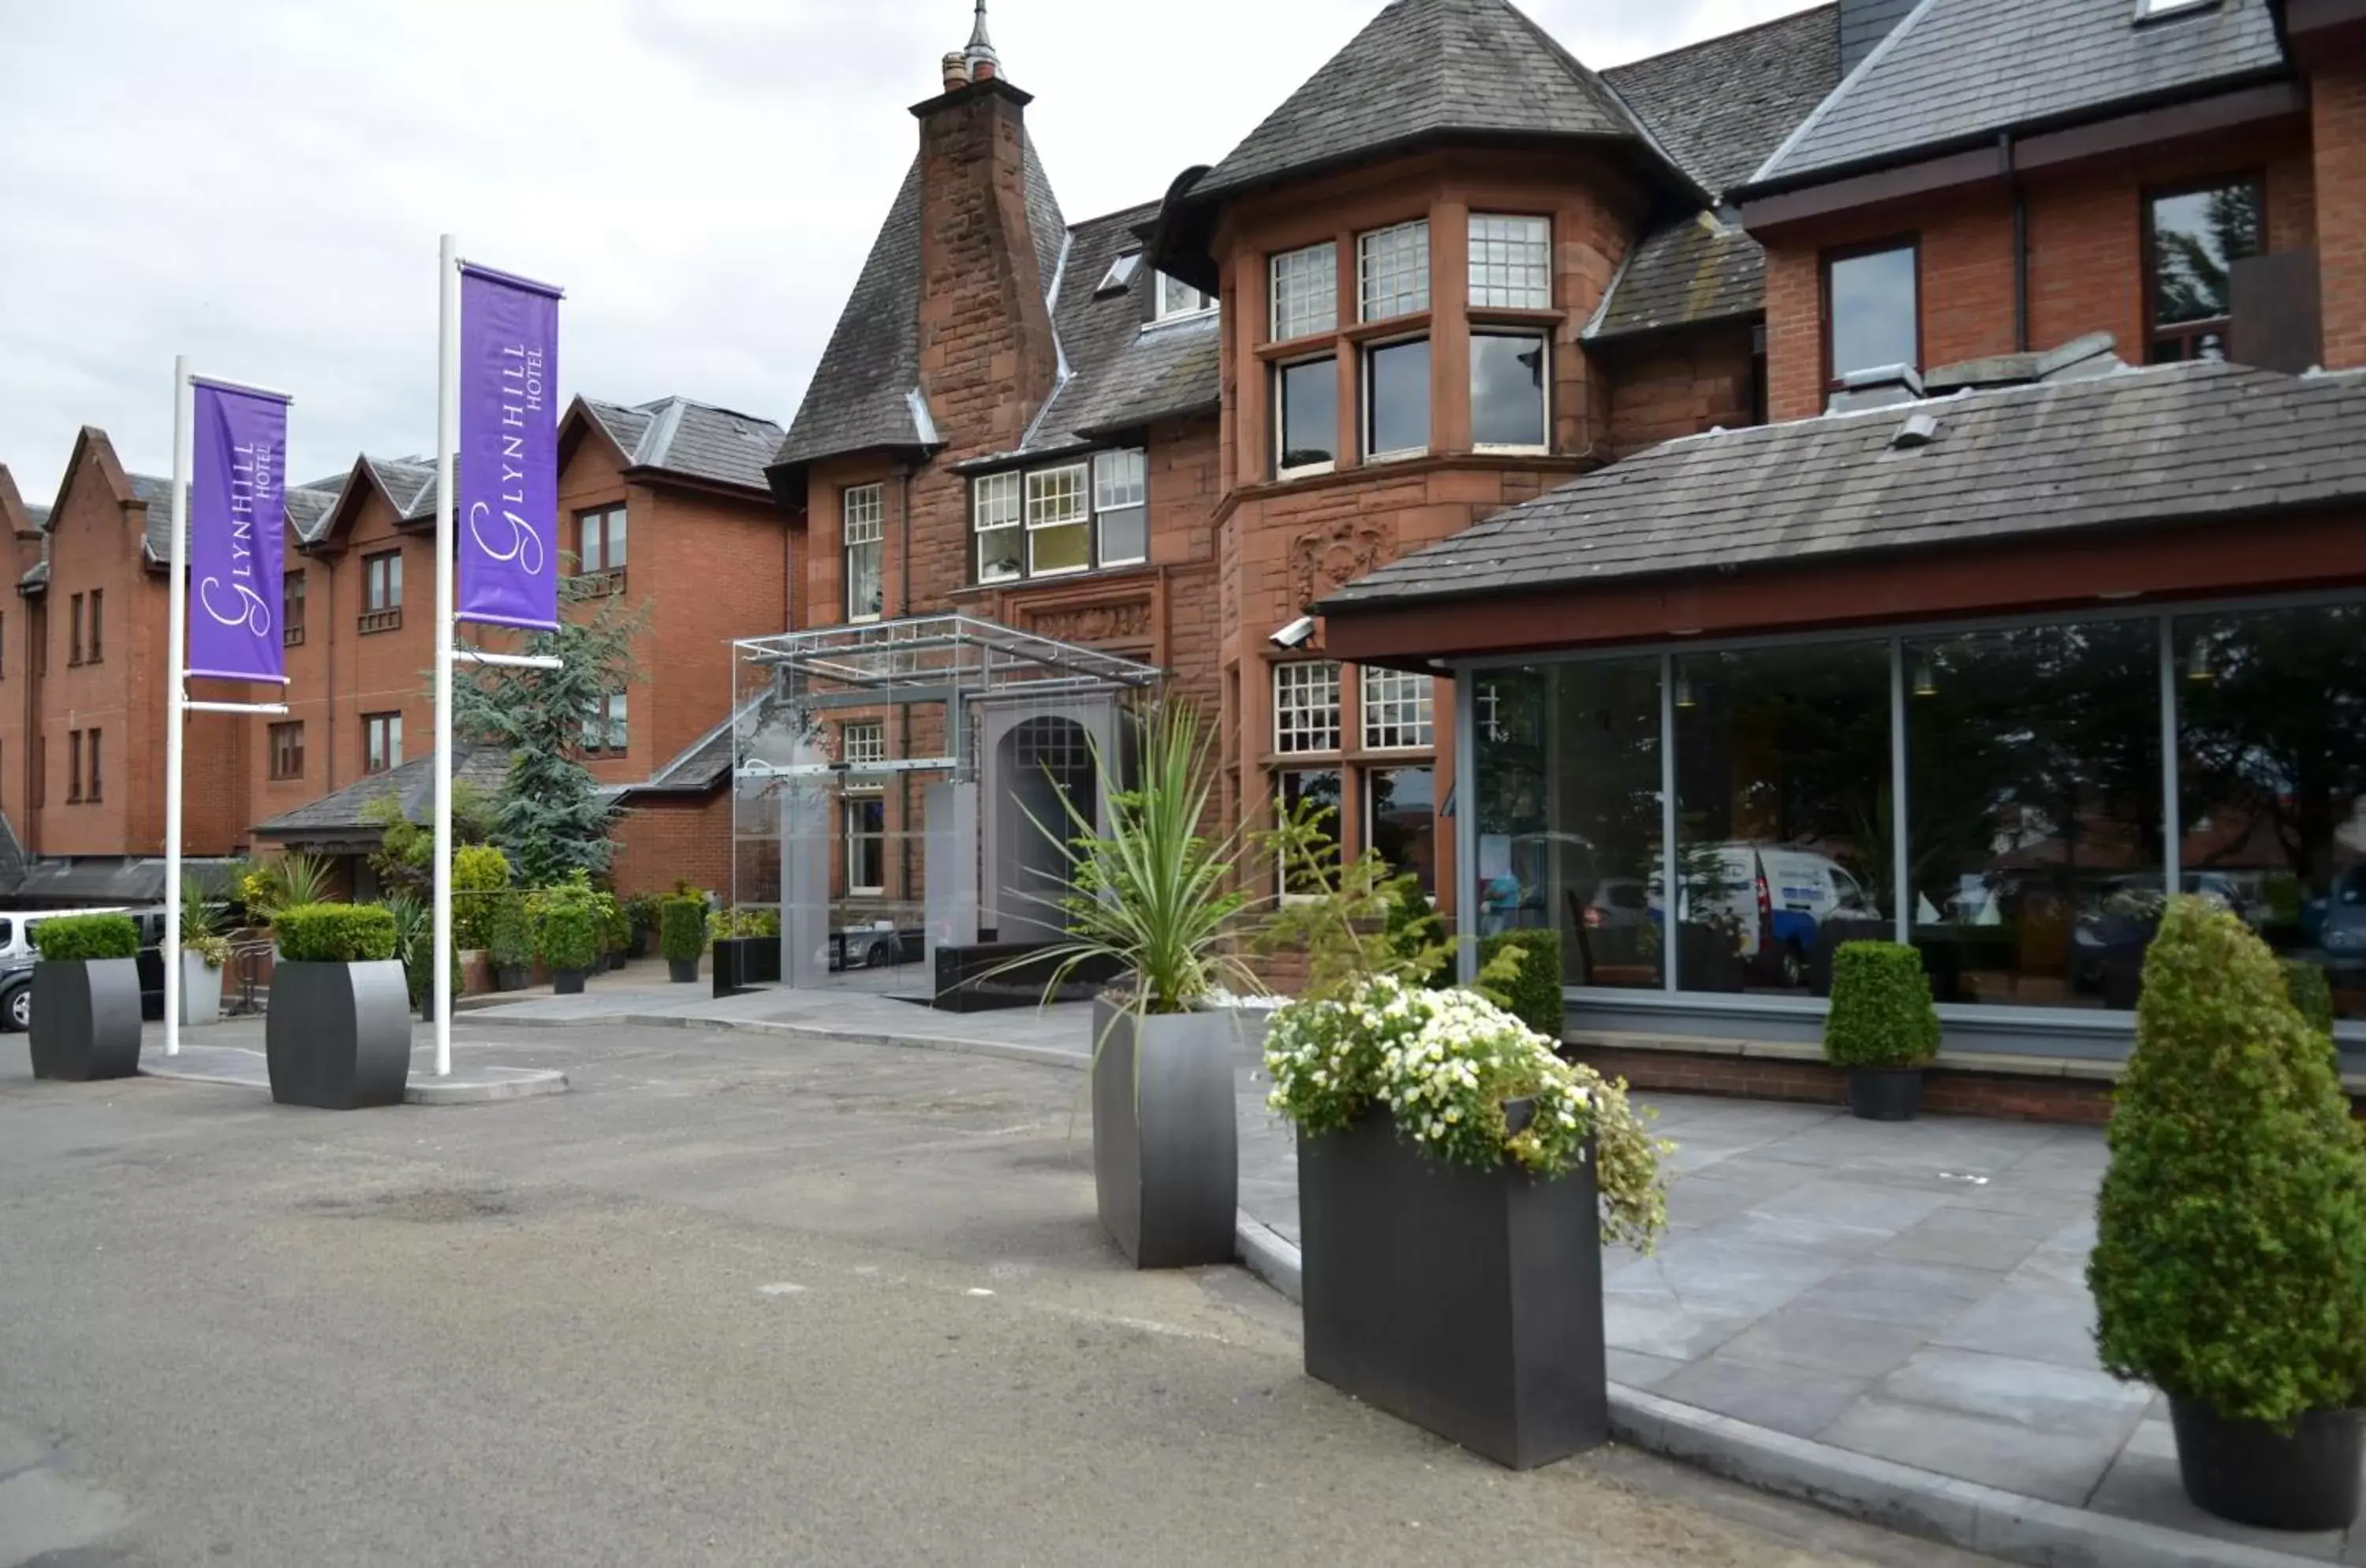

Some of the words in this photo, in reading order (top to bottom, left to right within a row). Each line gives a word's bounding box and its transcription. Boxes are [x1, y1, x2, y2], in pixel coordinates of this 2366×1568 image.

[526, 347, 543, 411] HOTEL
[255, 444, 271, 498] HOTEL
[470, 343, 543, 575] GLYNHILL
[201, 442, 270, 637] GLYNHILL
